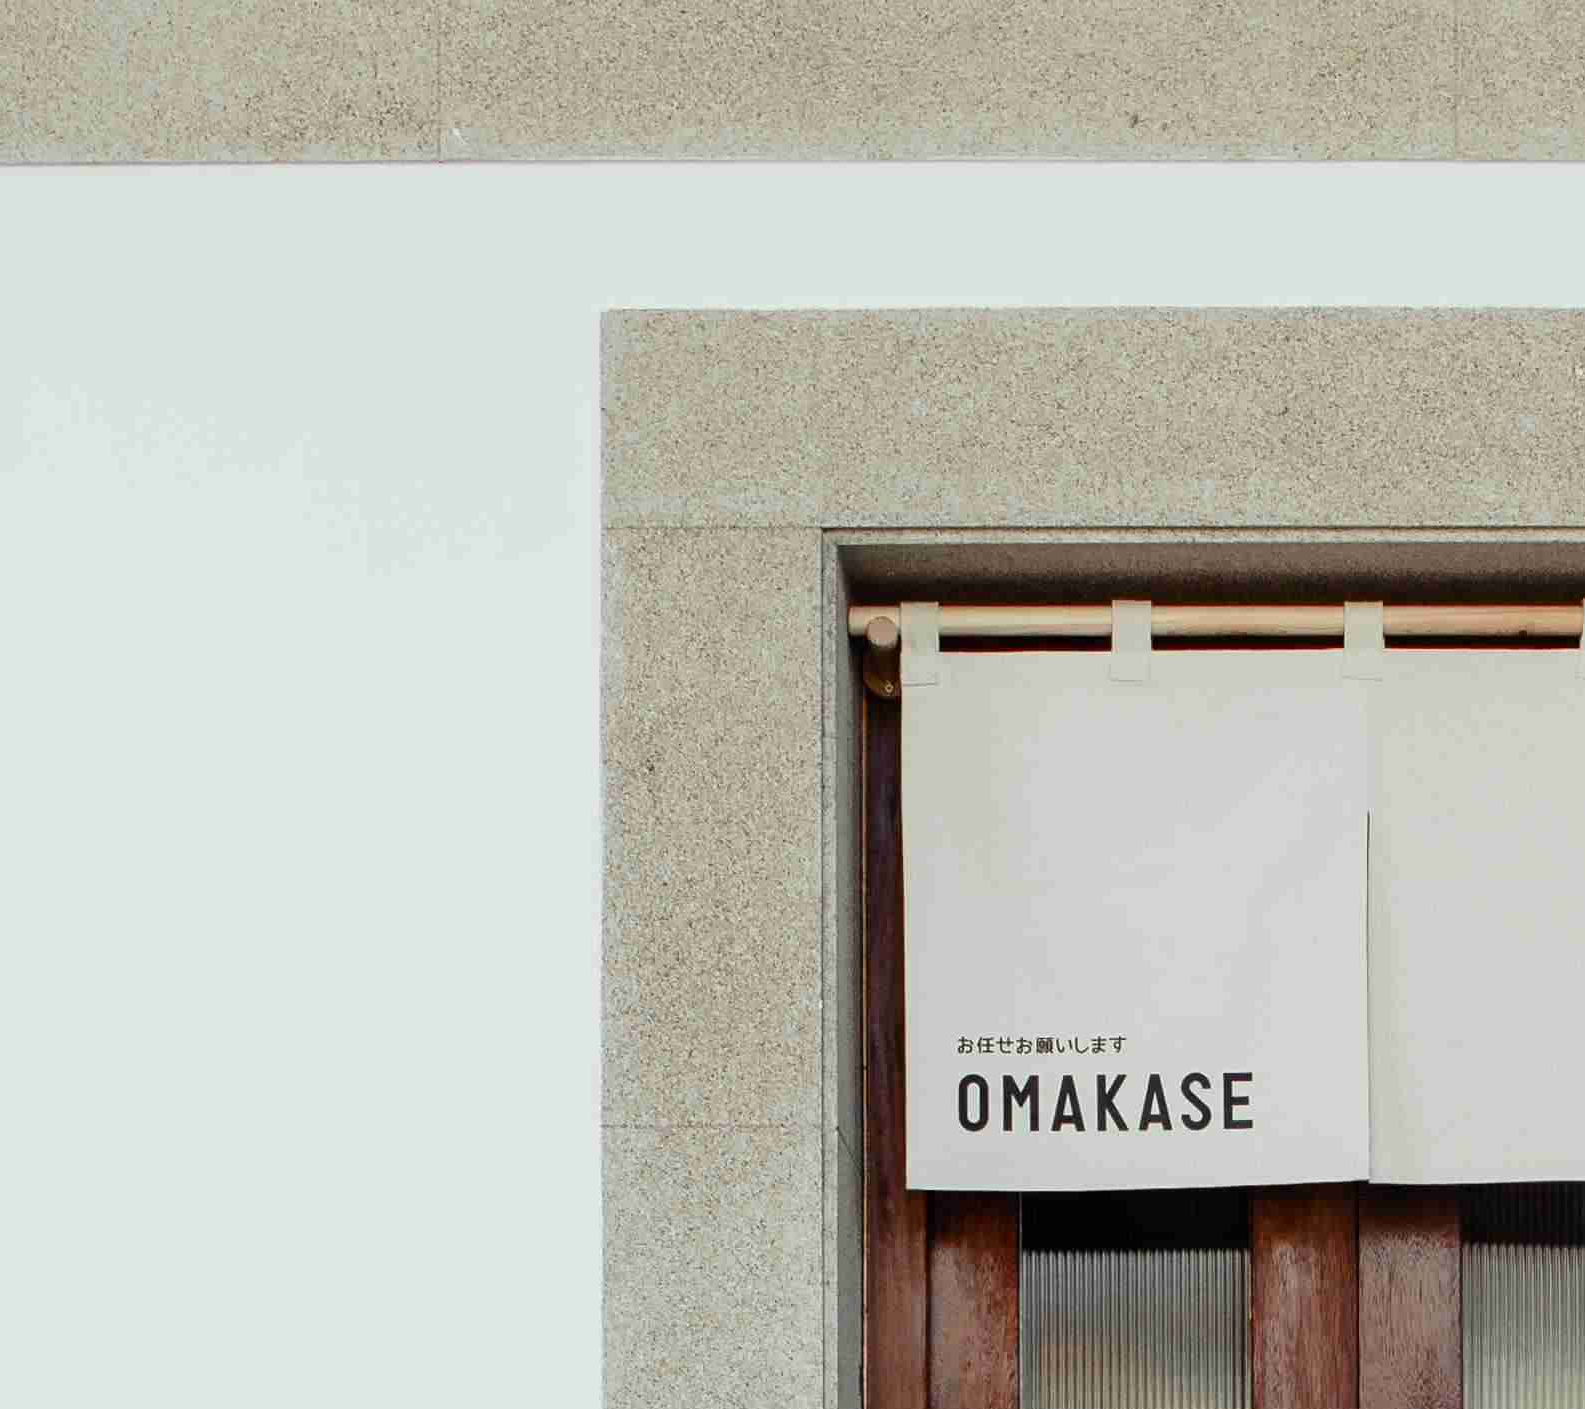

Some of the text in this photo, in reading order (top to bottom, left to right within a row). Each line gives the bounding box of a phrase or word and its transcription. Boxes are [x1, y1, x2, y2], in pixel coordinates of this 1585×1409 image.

[957, 1036, 1128, 1054] お任せお願いします
[957, 1071, 1254, 1132] OMAKASE
